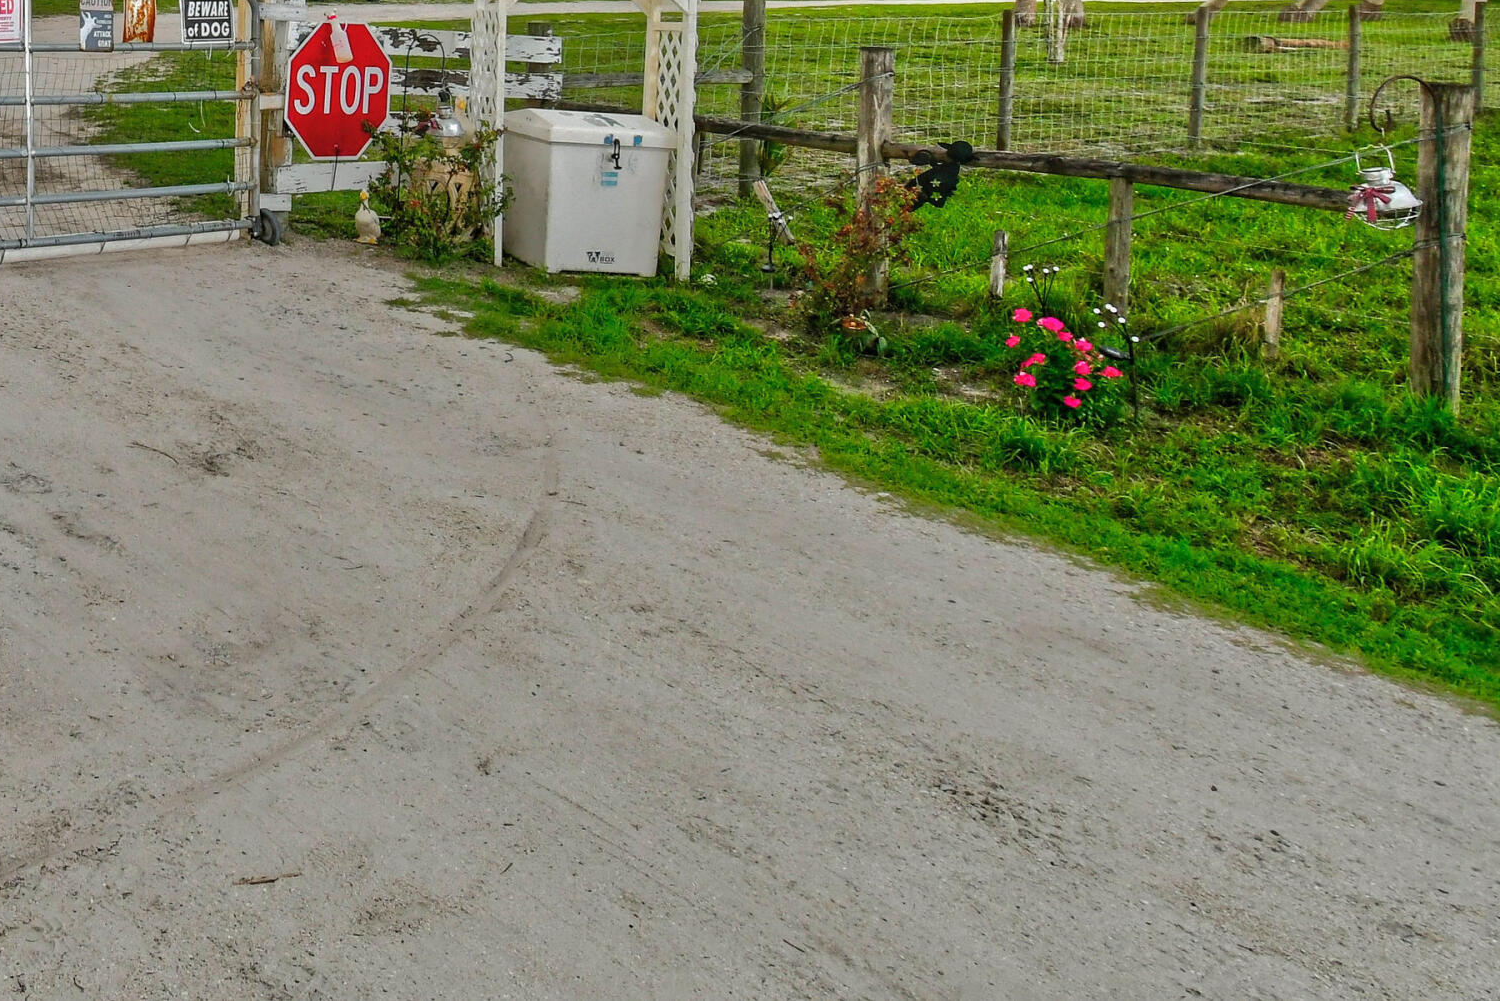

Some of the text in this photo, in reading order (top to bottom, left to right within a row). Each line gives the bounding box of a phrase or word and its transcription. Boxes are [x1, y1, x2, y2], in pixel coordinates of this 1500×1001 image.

[187, 1, 228, 17] BEWARE
[187, 22, 230, 37] of DOG
[294, 65, 384, 116] STOP
